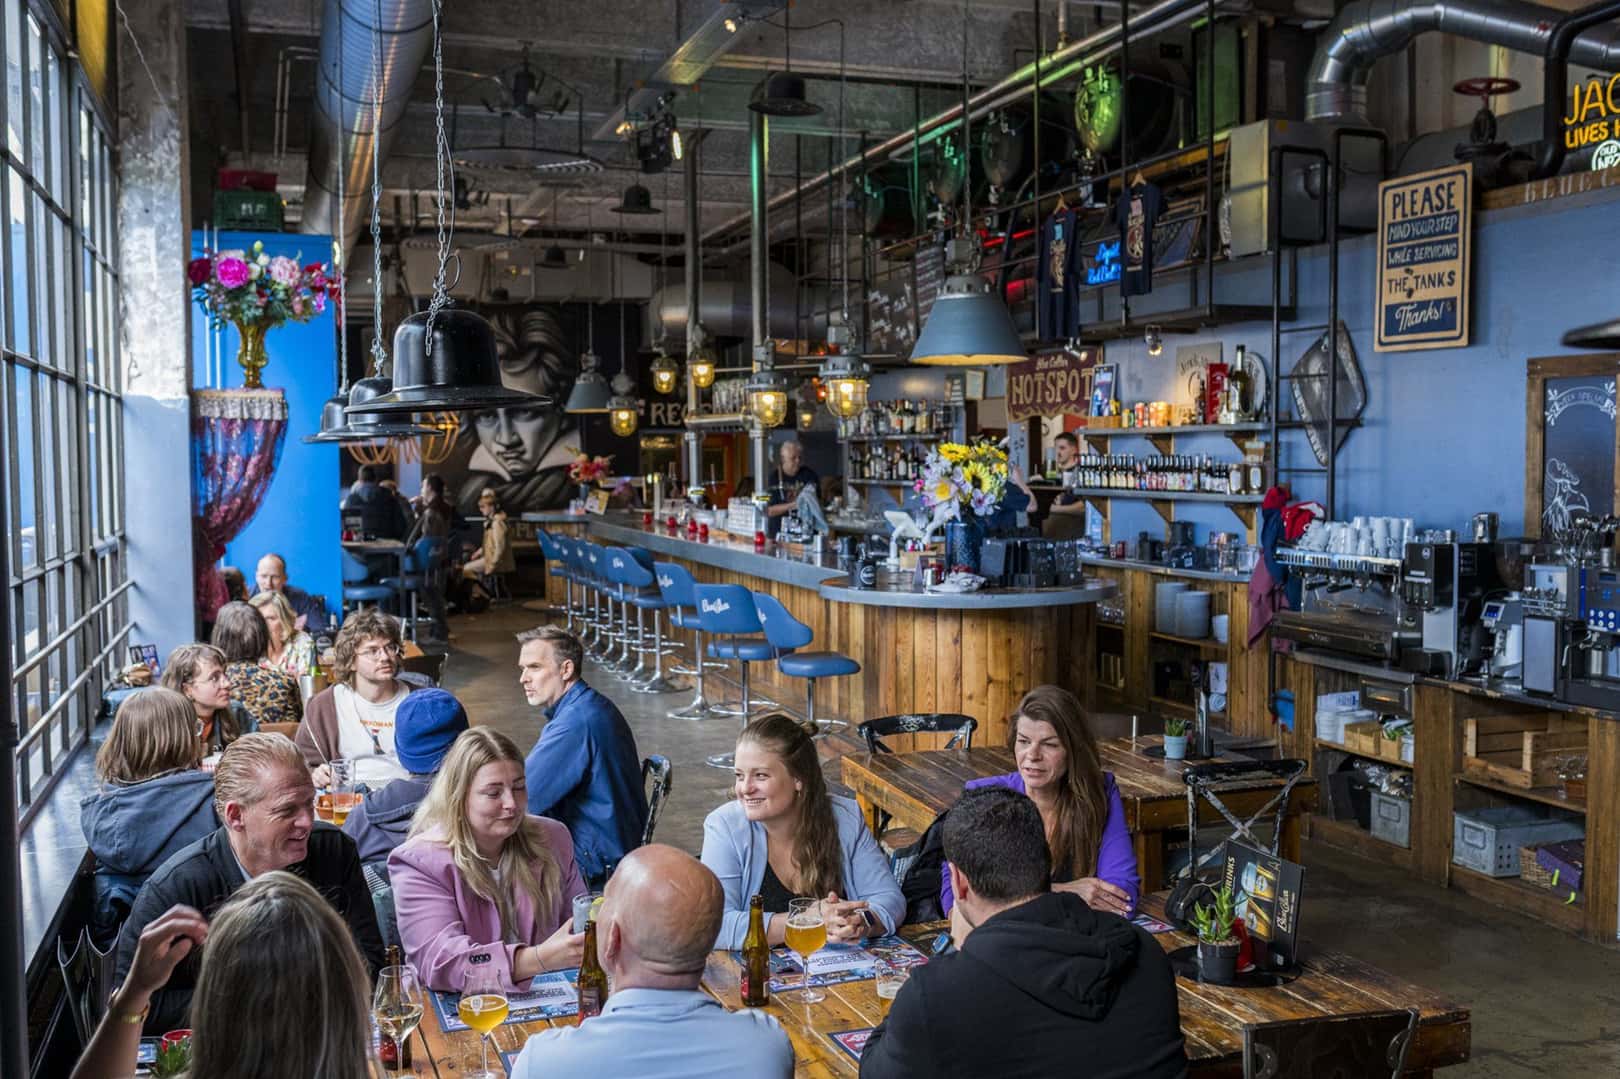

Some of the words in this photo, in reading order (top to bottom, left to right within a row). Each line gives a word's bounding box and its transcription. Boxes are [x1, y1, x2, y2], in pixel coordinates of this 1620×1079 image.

[1565, 121, 1609, 149] LIVES
[1600, 145, 1618, 155] OLD
[1392, 181, 1456, 220] PLEASE
[1388, 223, 1411, 241] MIND
[1411, 217, 1436, 238] YOUR
[1435, 215, 1458, 233] STEP
[1388, 247, 1412, 265] WHILE
[1414, 242, 1457, 260] SERVICING
[1388, 277, 1408, 294] THE
[1413, 270, 1456, 290] TANKS
[1394, 301, 1445, 333] Thanks!
[1011, 368, 1094, 405] HOTSPOT
